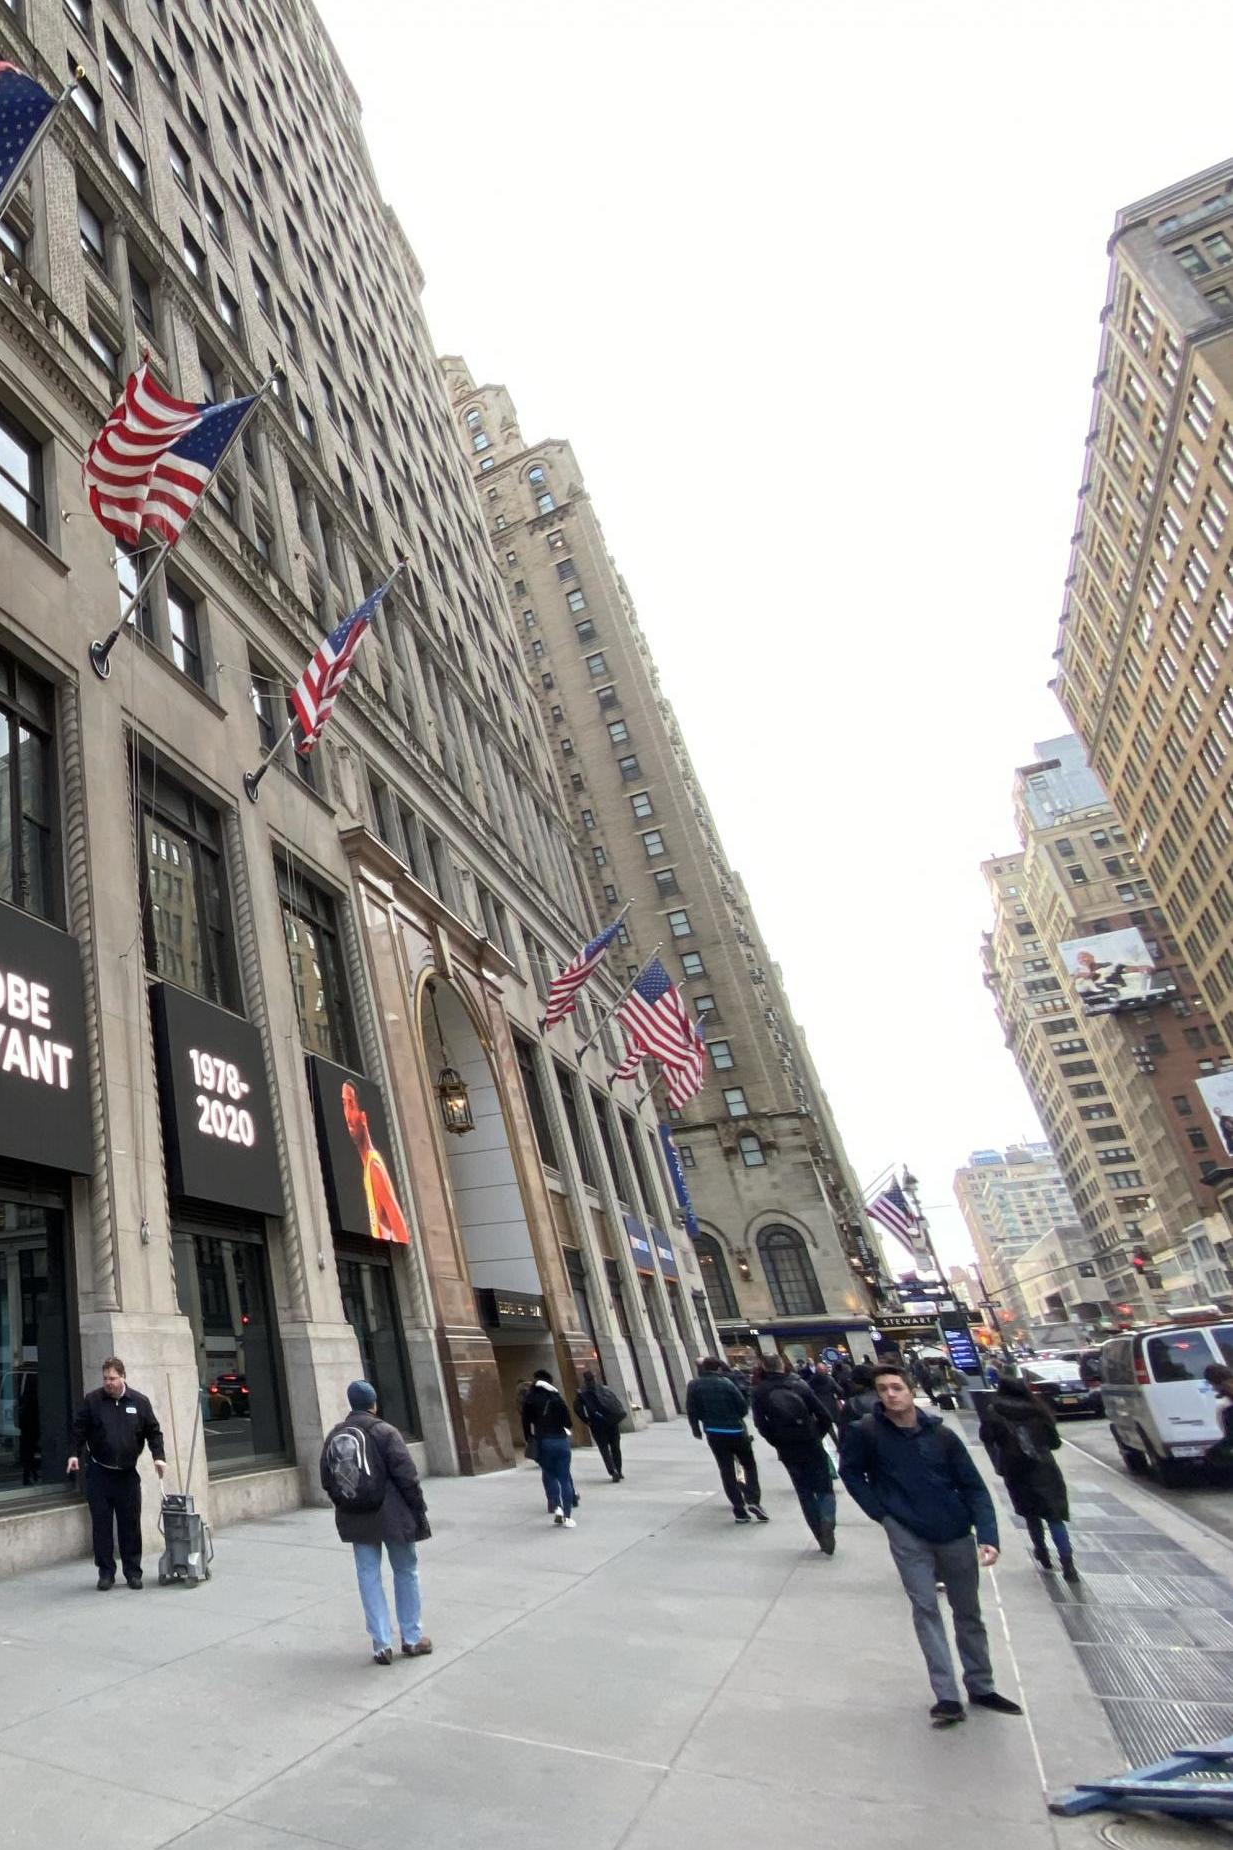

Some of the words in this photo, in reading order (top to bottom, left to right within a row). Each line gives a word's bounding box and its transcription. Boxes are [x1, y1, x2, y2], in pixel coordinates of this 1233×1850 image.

[189, 1048, 250, 1100] 1978-
[196, 1095, 254, 1147] 2020
[882, 1315, 932, 1326] STEWART
